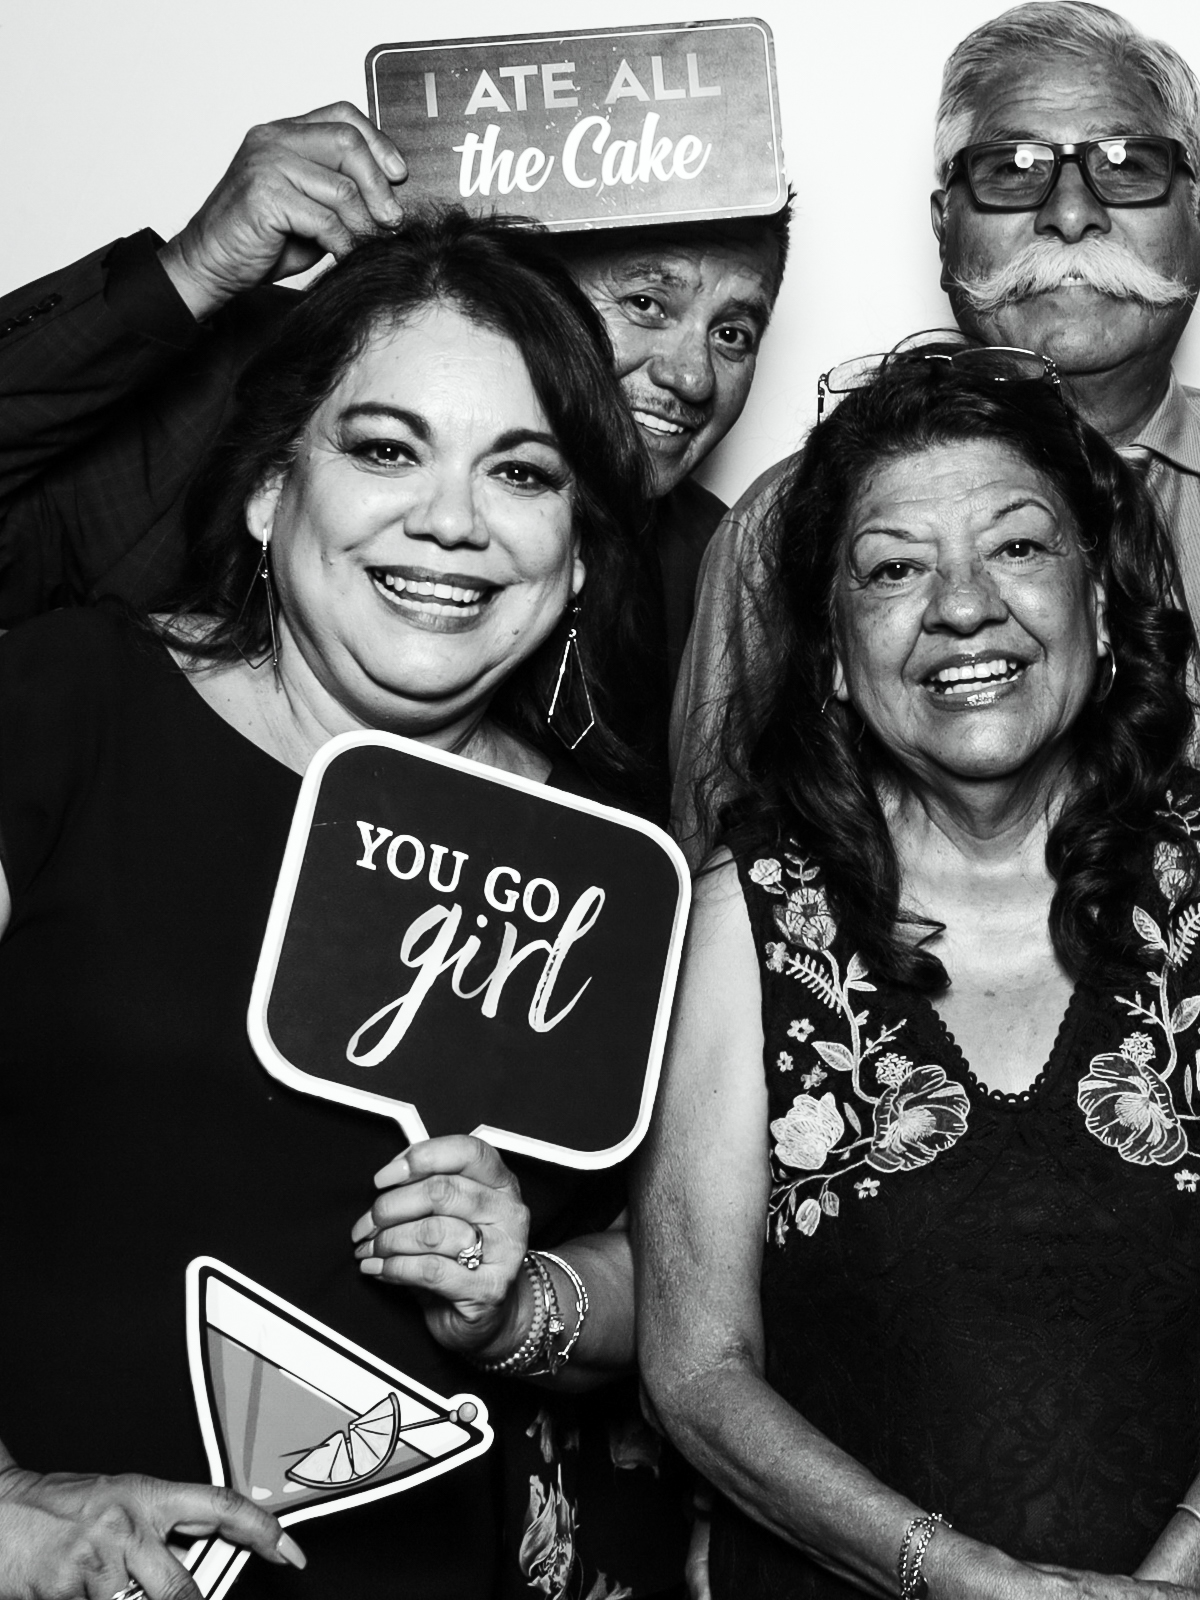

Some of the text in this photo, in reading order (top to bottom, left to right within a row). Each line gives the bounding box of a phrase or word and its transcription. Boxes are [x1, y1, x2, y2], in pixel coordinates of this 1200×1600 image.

[424, 52, 722, 118] I ATE ALL
[452, 111, 713, 198] the Cake
[355, 820, 560, 923] YOU GO
[346, 885, 607, 1068] girl
